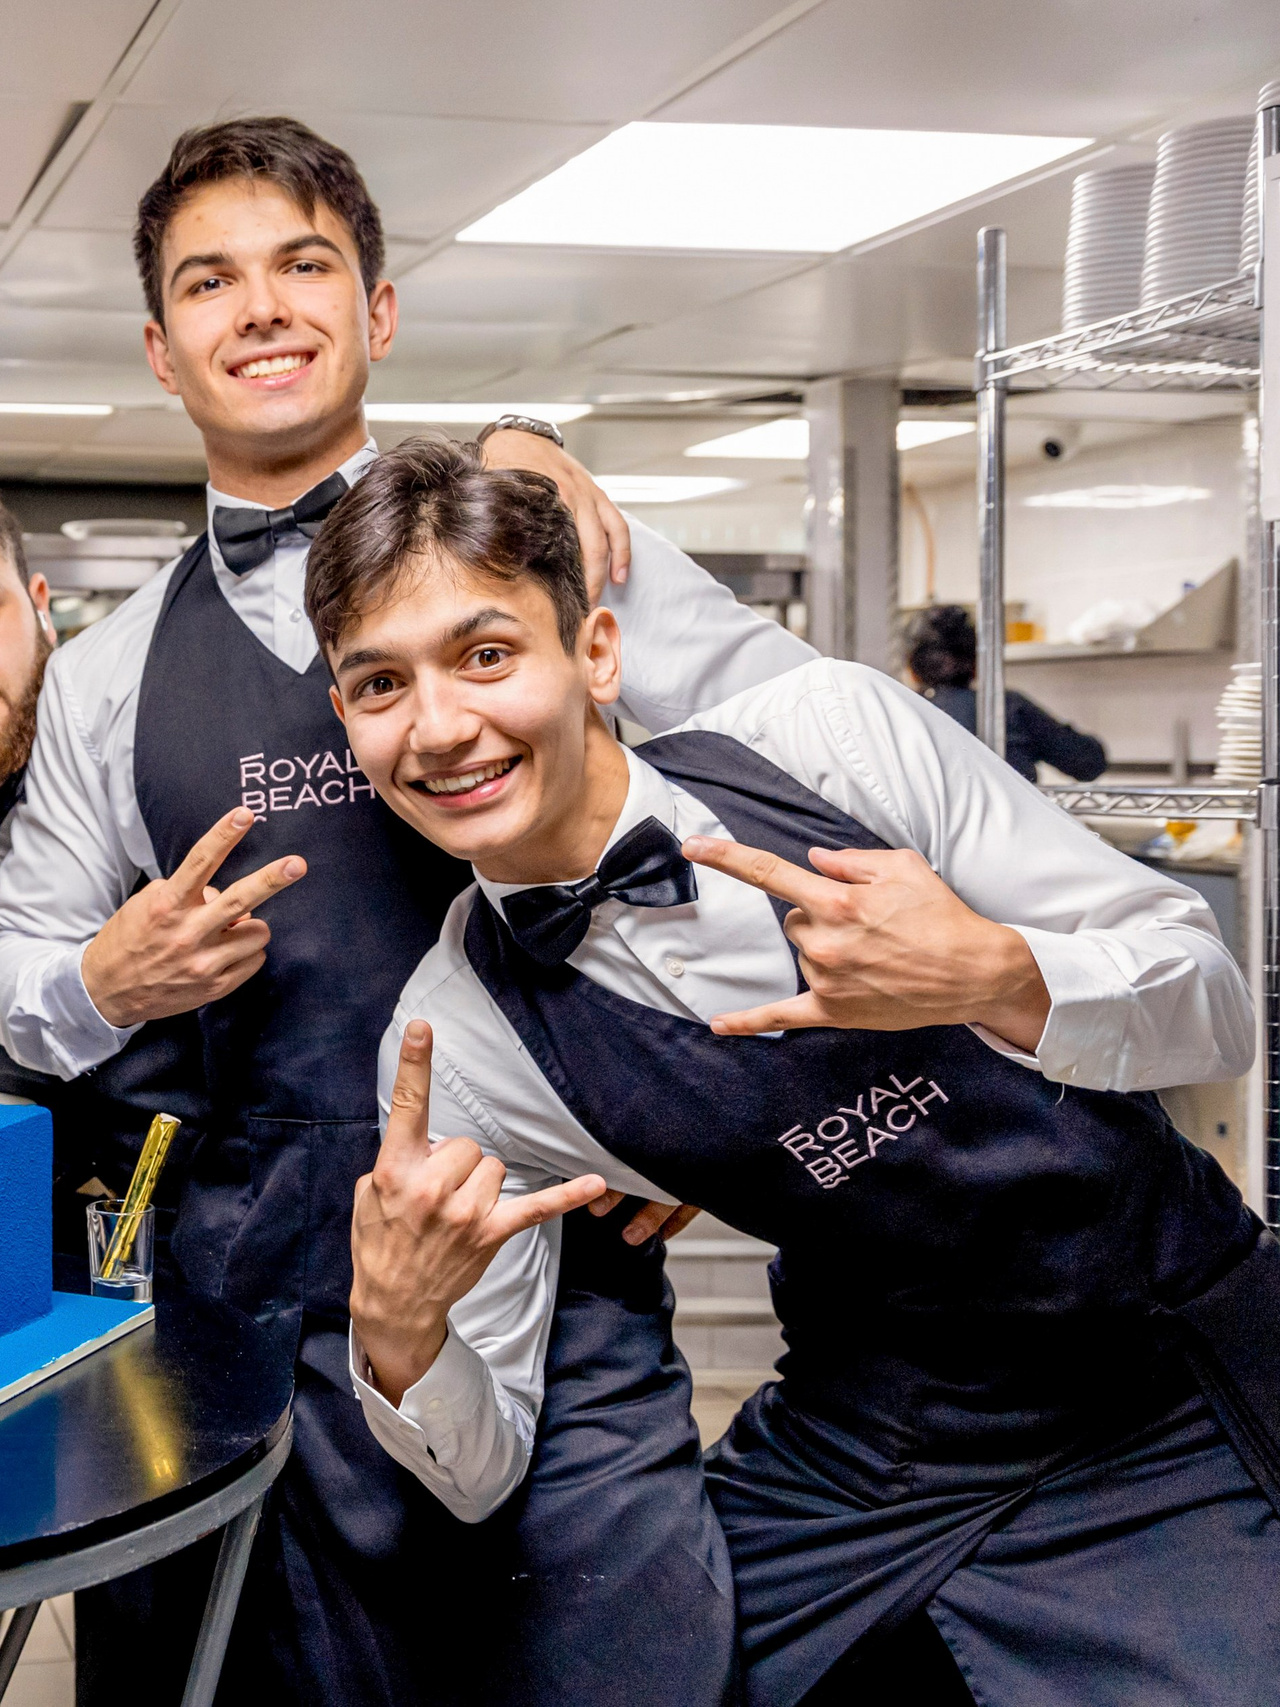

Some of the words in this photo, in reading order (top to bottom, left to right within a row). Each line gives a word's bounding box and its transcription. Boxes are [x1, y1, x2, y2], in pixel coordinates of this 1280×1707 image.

[239, 749, 361, 788] ROYAL
[241, 777, 376, 815] BEACH
[777, 1074, 924, 1161] ROYAL
[805, 1080, 950, 1186] BEACH
